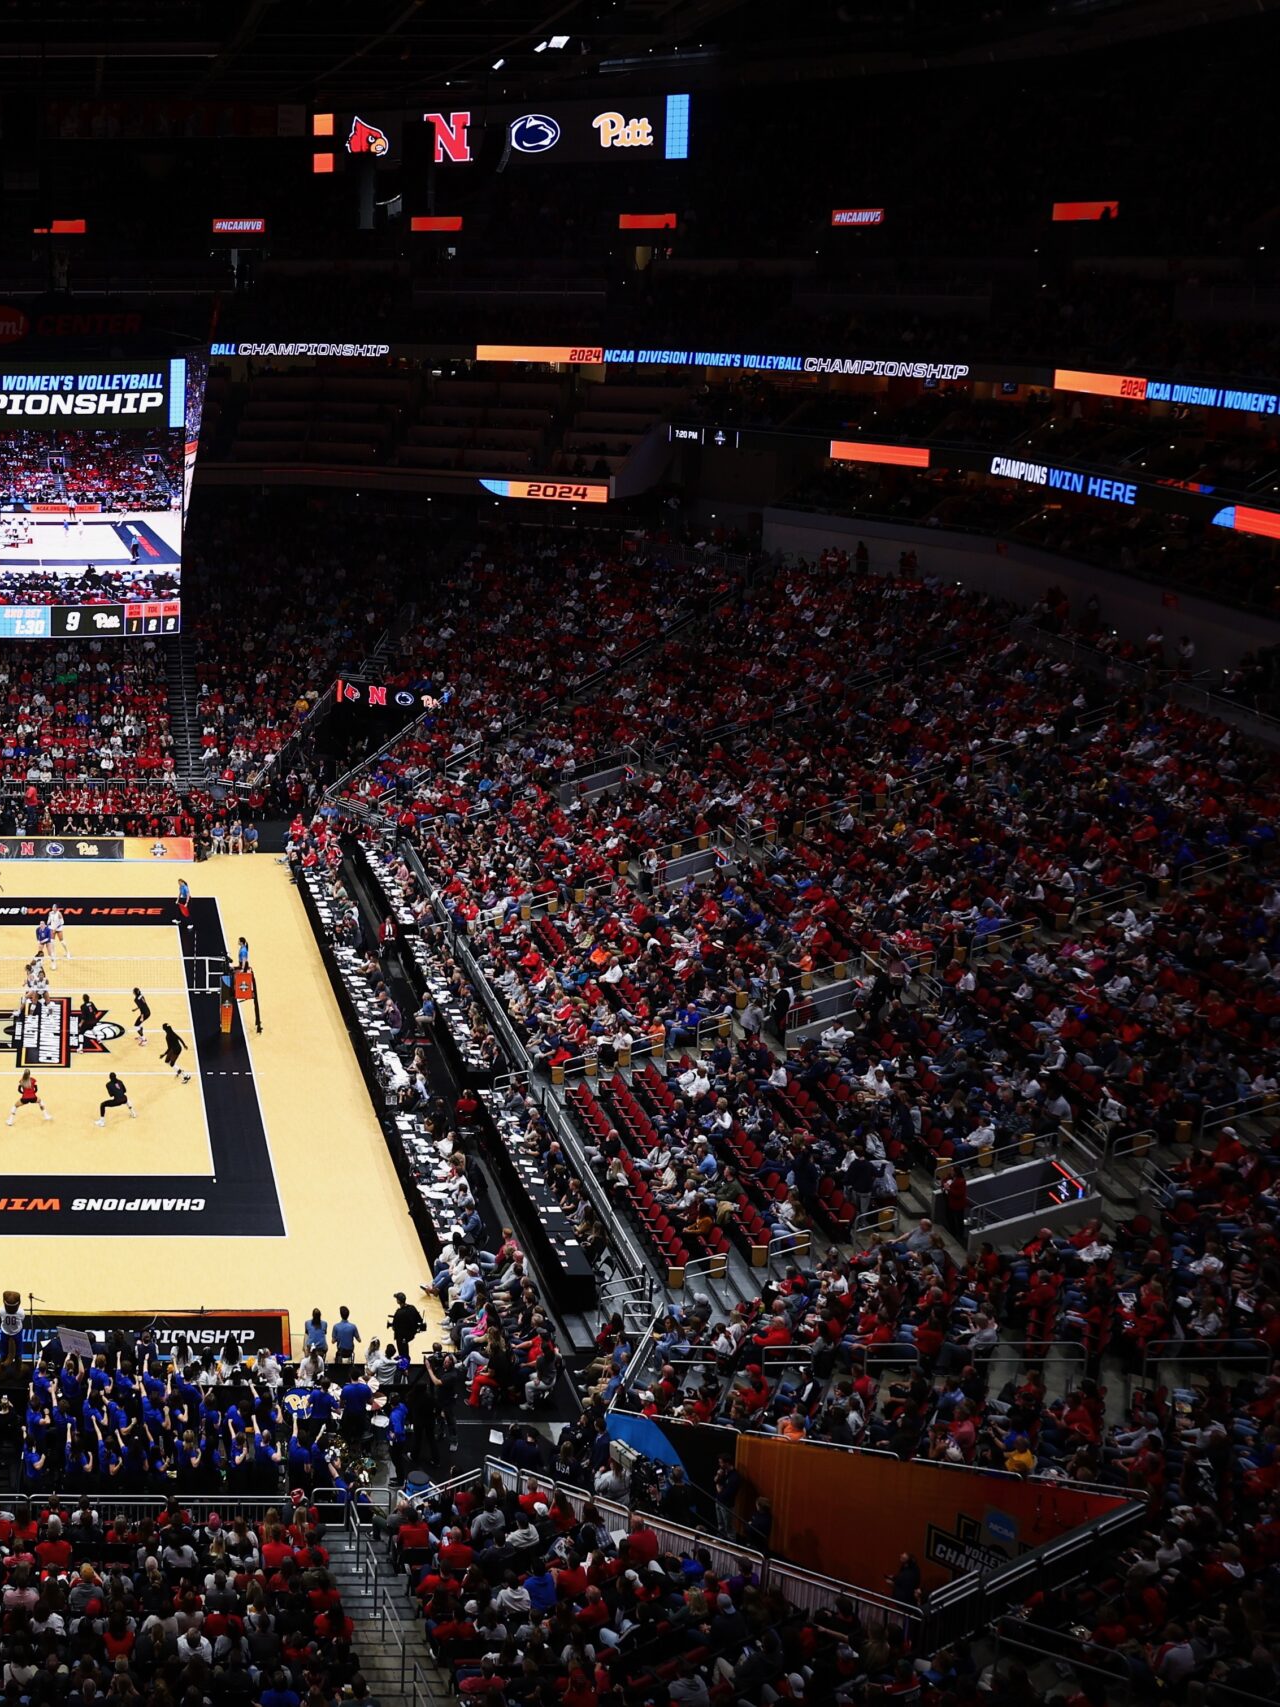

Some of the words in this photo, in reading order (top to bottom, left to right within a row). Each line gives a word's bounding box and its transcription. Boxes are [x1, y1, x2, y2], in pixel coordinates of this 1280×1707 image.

[423, 112, 470, 163] N
[592, 111, 652, 148] Pitt
[215, 221, 262, 231] #NCAAWVB
[35, 310, 145, 336] CENTER
[238, 343, 390, 357] CHAMPIONSHIP
[569, 349, 602, 362] 2024
[604, 349, 634, 363] NCAA
[636, 350, 687, 365] DIVISION
[694, 352, 741, 368] WOMEN'S
[742, 355, 802, 371] VOLLEYBALL
[803, 357, 970, 381] CHAMPIONSHIP
[2, 374, 74, 391] WOMEN'S
[77, 373, 163, 390] VOLLEYBALL
[1121, 379, 1145, 397] 2024
[1147, 382, 1170, 399] NCAA
[1172, 384, 1218, 407] DIVISION
[1223, 391, 1275, 414] WOMEN'S
[675, 429, 687, 439] 7:20
[689, 431, 698, 440] PM
[990, 456, 1048, 485] CHAMPIONS
[1048, 468, 1083, 493] WIN
[1087, 477, 1138, 505] HERE
[526, 483, 588, 500] 2024
[15, 619, 45, 634] 1:30
[66, 611, 81, 631] 9
[93, 612, 120, 629] Pitt
[131, 620, 137, 632] 1
[368, 685, 387, 706] N
[21, 842, 35, 856] N
[76, 841, 99, 856] Pitt
[91, 907, 164, 916] HERE
[23, 1014, 39, 1048] VOLLEYBALL
[71, 1199, 206, 1212] CHAMPIONS
[555, 1461, 571, 1475] USA
